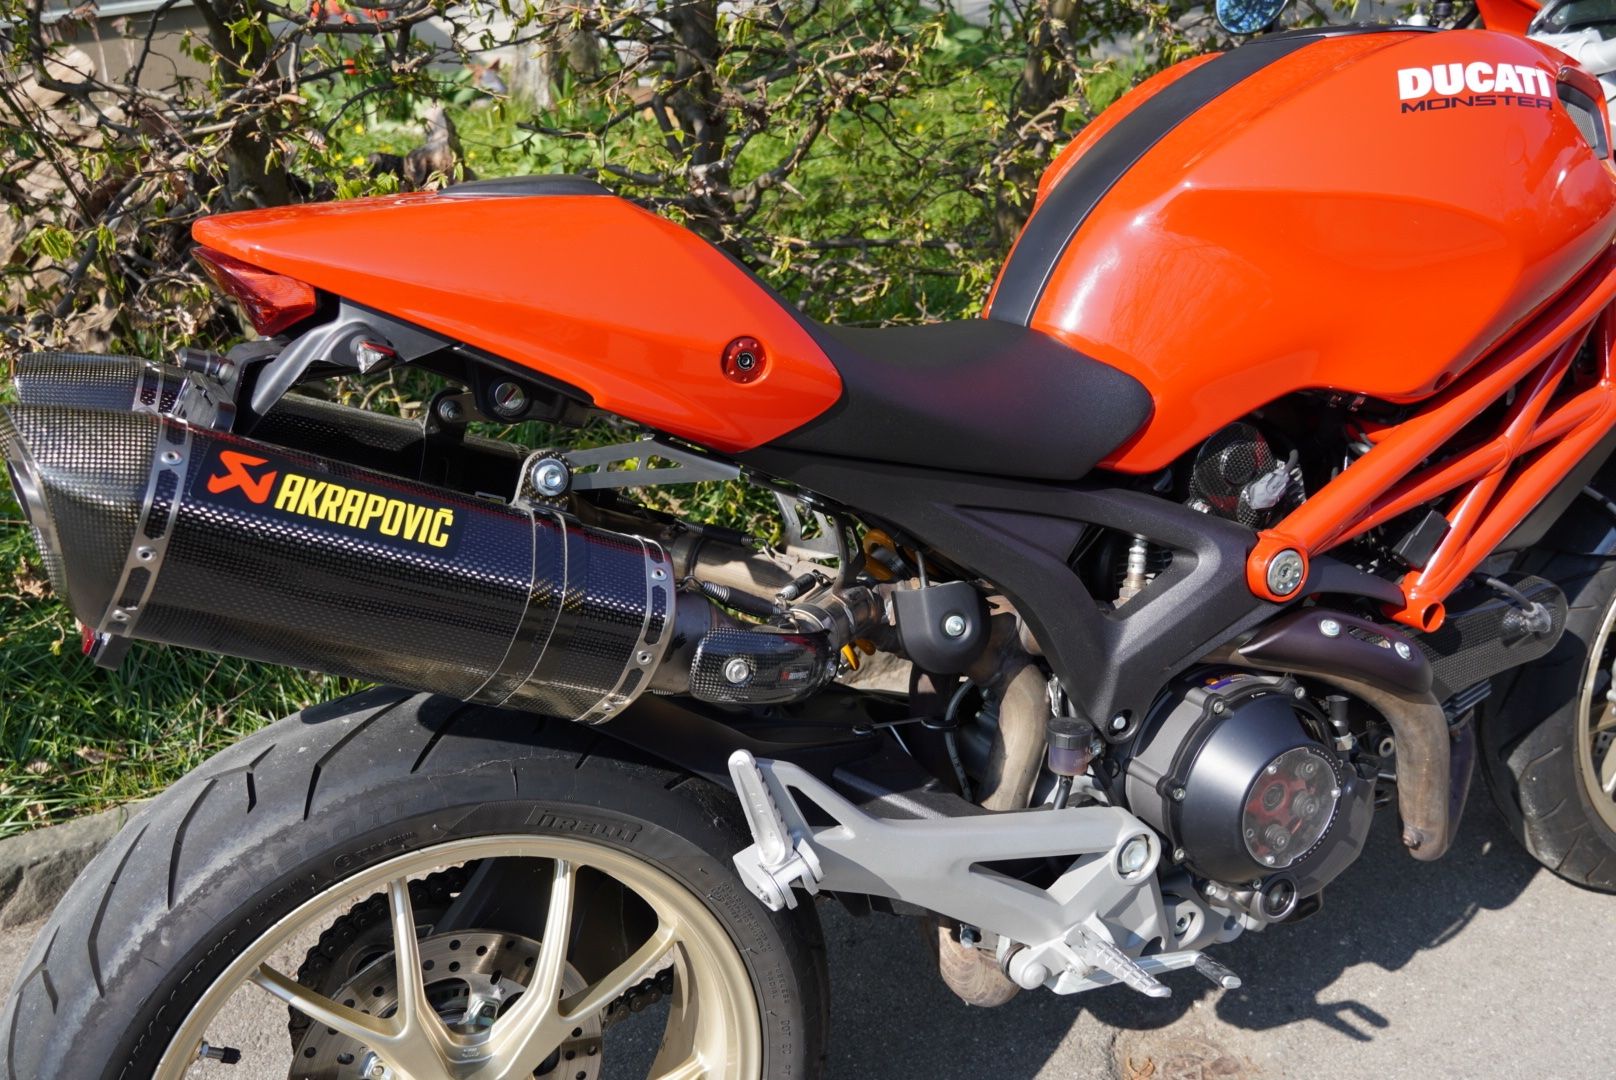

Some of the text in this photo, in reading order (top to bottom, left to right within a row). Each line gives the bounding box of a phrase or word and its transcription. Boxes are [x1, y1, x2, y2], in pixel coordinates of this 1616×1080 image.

[1397, 61, 1551, 100] DUCATI
[1401, 95, 1553, 114] MONSTER
[273, 473, 454, 548] AKRAPOVIČ
